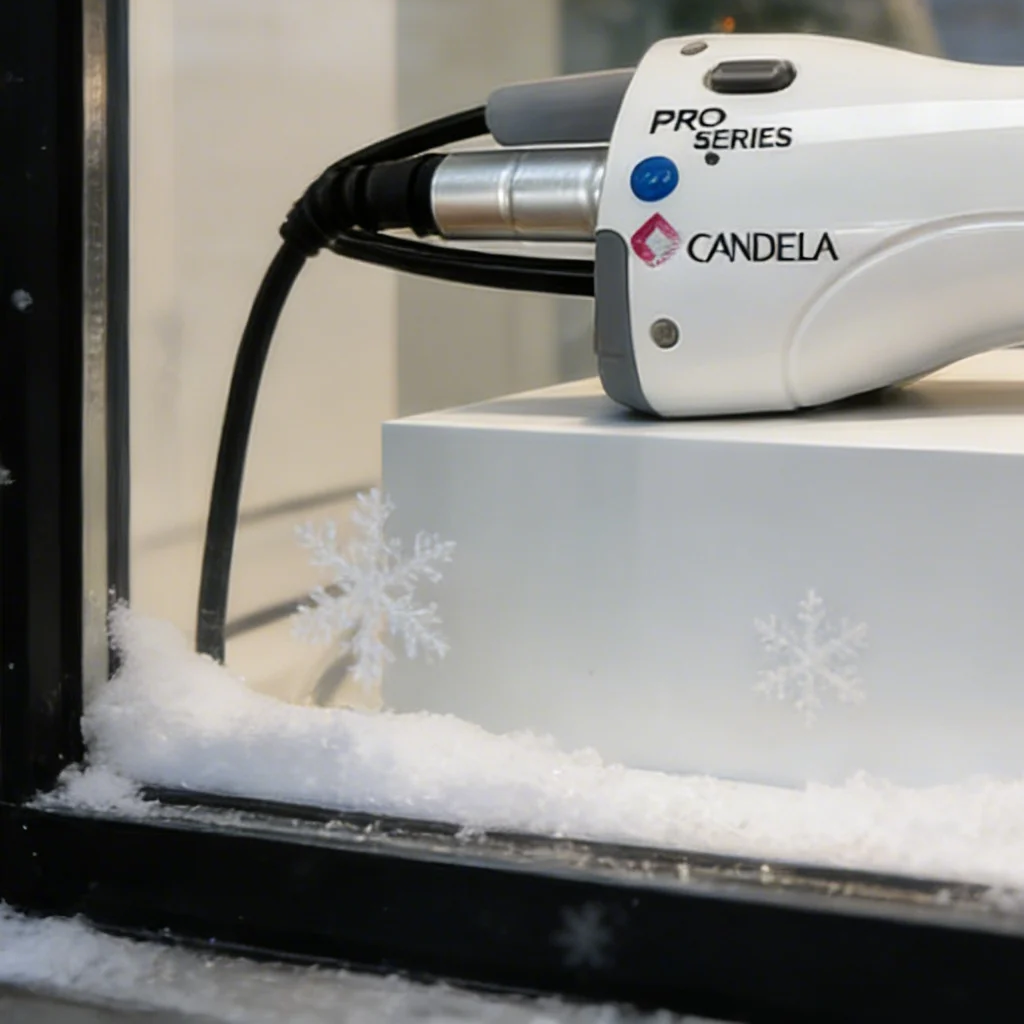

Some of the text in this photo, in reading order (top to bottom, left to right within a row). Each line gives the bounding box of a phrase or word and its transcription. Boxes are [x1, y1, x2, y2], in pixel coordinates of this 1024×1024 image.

[650, 107, 727, 134] PRO
[693, 127, 793, 150] SERIES
[687, 231, 839, 263] CANDELA
